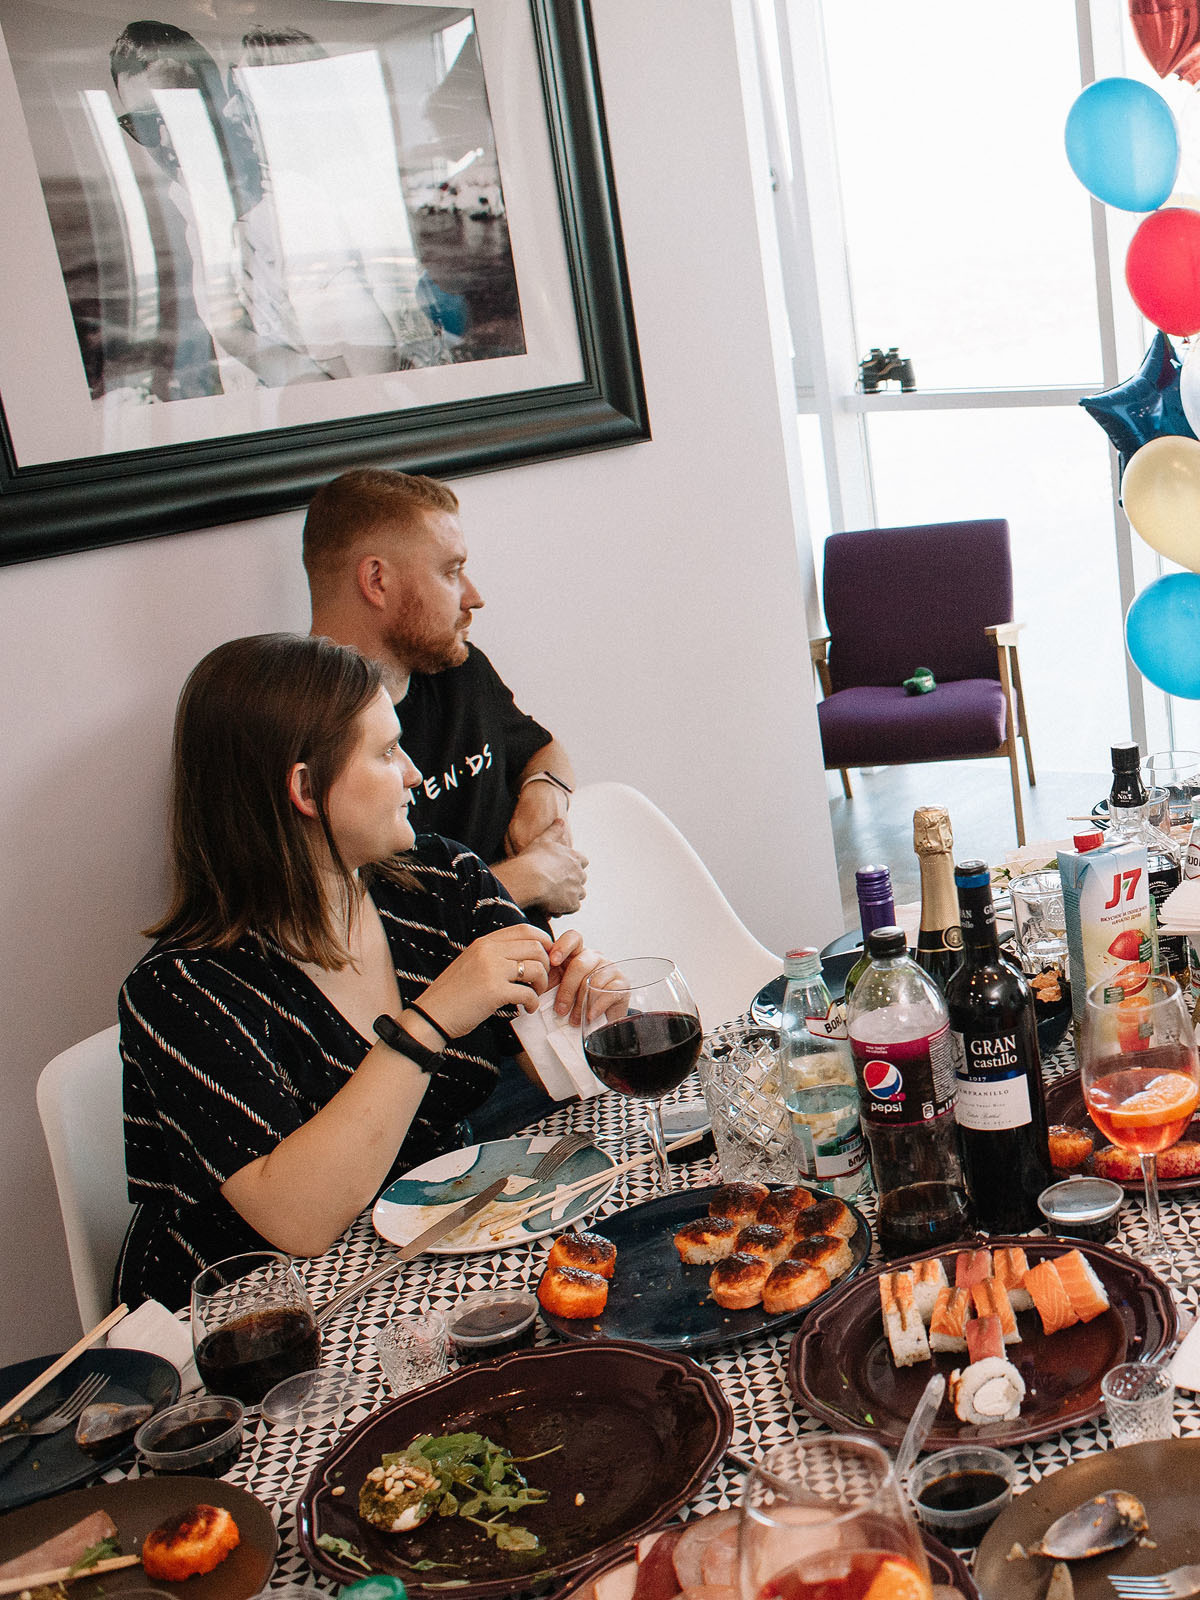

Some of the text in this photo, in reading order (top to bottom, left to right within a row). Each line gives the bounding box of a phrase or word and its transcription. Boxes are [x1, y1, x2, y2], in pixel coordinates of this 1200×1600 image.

[1104, 868, 1142, 910] J7
[970, 1034, 1017, 1056] GRAN
[973, 1053, 1018, 1068] castillo
[870, 1101, 903, 1115] pepsi
